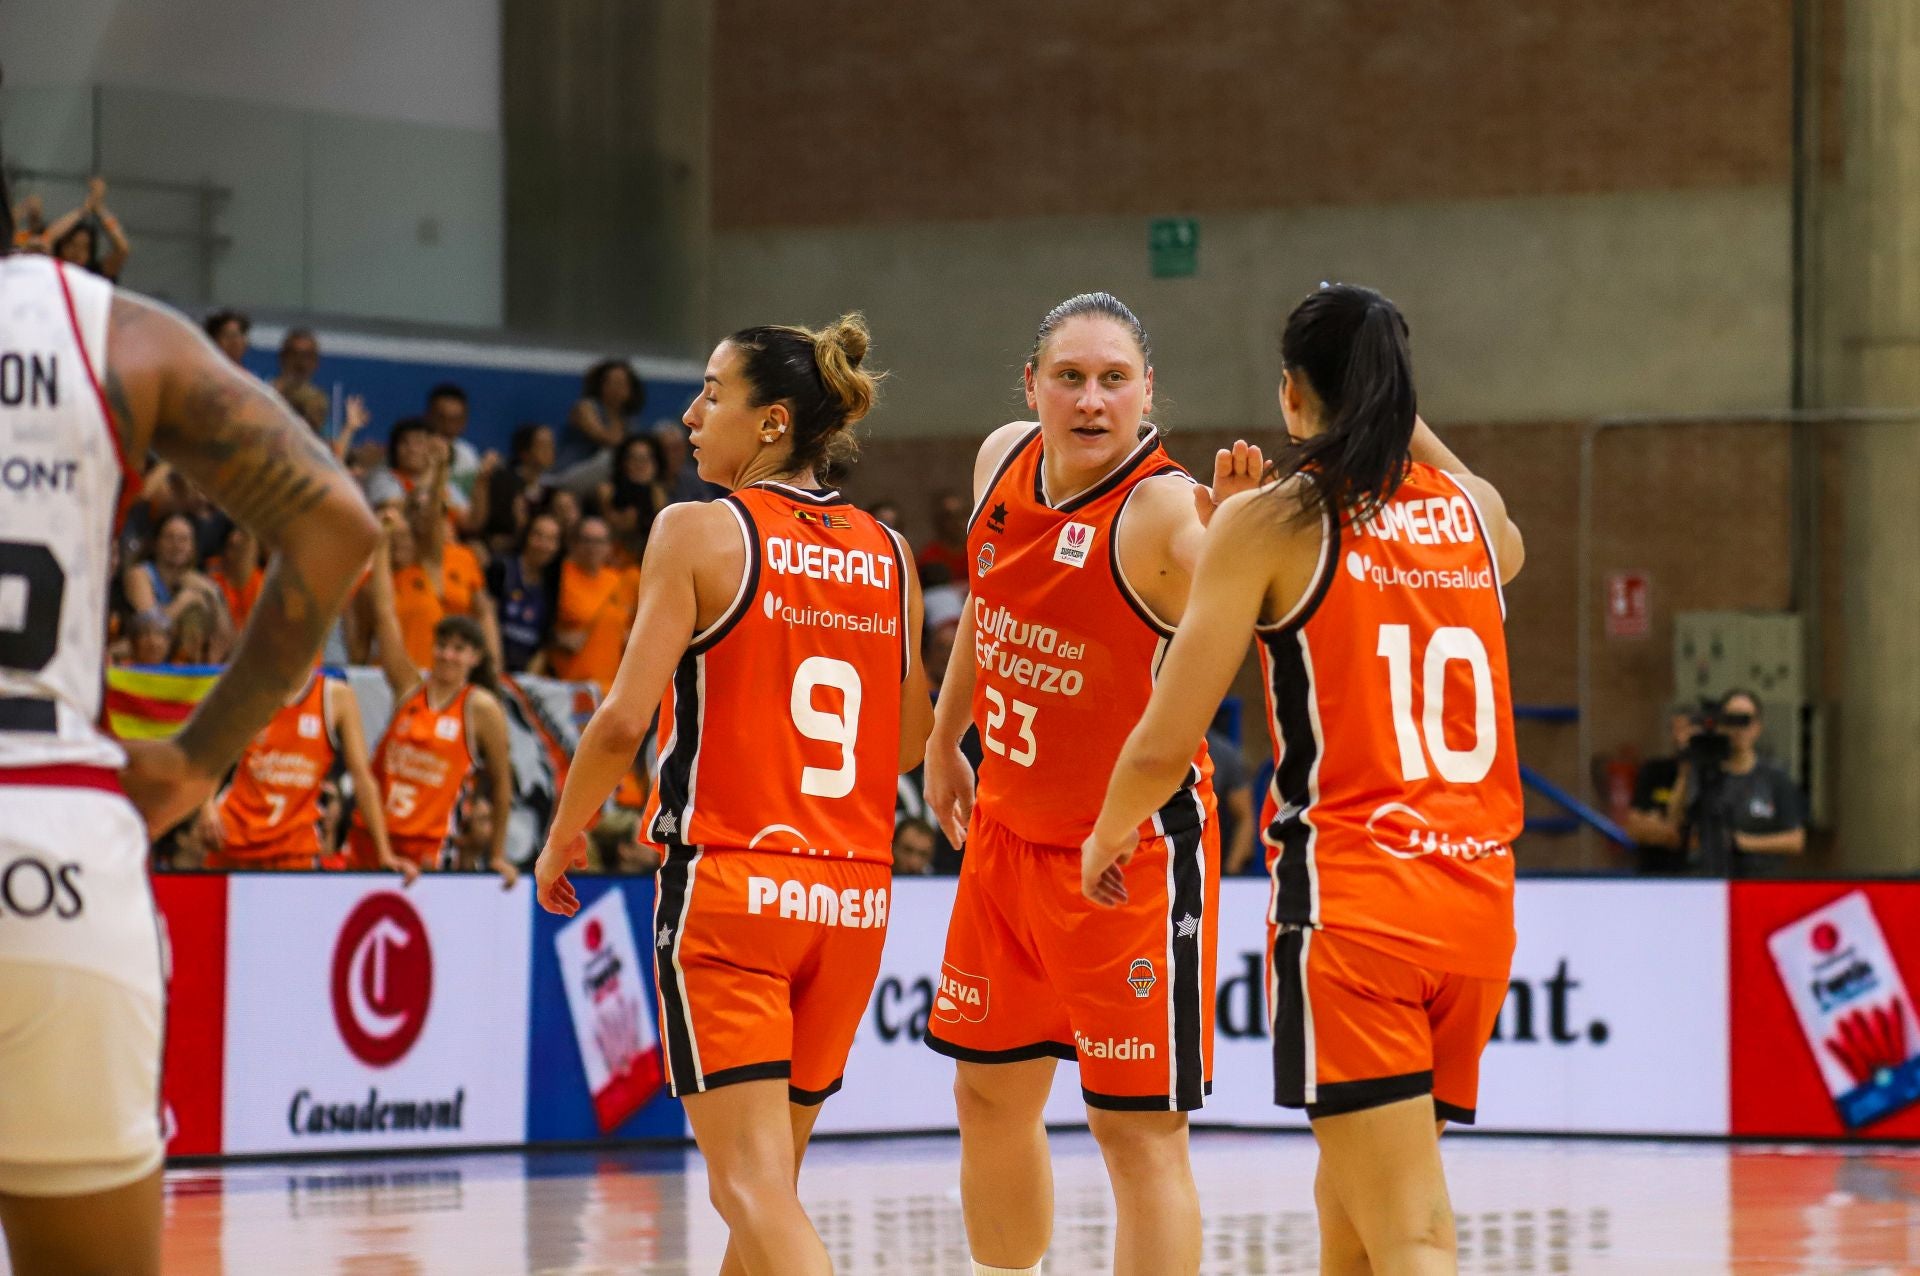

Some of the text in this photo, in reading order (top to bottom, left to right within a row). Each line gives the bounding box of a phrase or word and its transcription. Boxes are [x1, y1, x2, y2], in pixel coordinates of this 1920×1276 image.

[766, 536, 893, 590] QUERALT
[1371, 565, 1491, 592] qurónsalud
[974, 596, 1085, 660] Cultura del
[790, 655, 862, 799] 9
[985, 685, 1039, 768] 23
[1376, 624, 1497, 783] 10
[265, 794, 287, 827] 7
[748, 876, 887, 929] PAMESA
[938, 972, 981, 1006] LEVA
[1075, 1030, 1155, 1060] taldin
